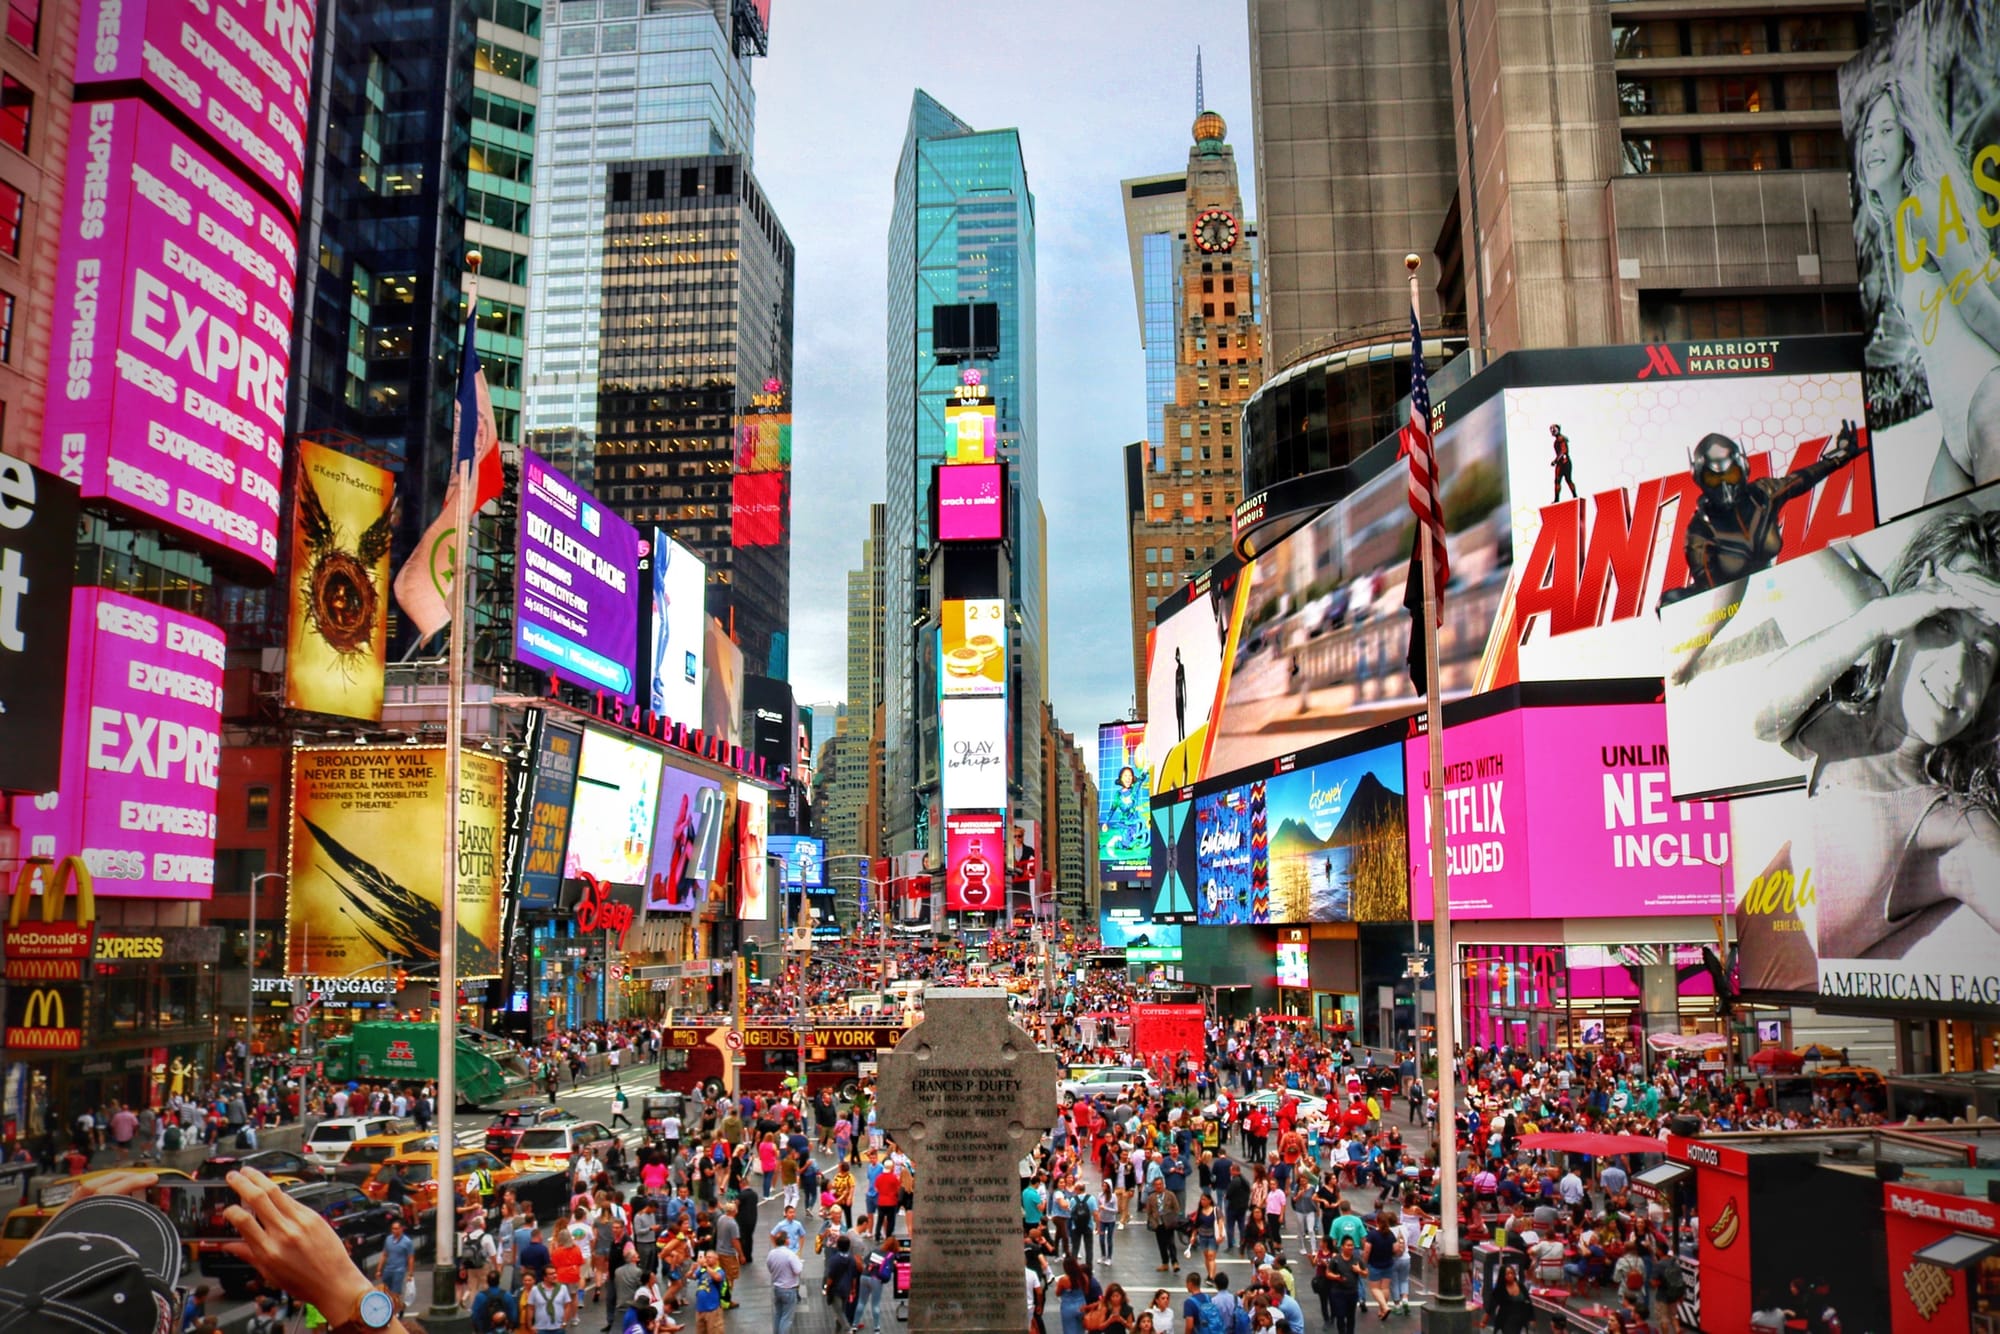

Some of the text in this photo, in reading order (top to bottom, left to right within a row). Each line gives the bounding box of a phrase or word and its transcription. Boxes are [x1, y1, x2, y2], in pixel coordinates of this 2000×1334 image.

[216, 5, 292, 94] EXPRESS
[180, 22, 263, 113] EXPRESS
[208, 97, 285, 181] EXPRESS
[81, 103, 114, 240] EXPRESS
[171, 143, 254, 226] EXPRESS
[198, 213, 276, 288] EXPRESS
[163, 239, 247, 316] EXPRESS
[66, 259, 101, 401] EXPRESS
[1689, 342, 1780, 357] MARRIOTT
[1689, 357, 1771, 372] MARQUIS
[183, 387, 265, 452] EXPRESS
[148, 420, 236, 485] EXPRESS
[313, 463, 385, 497] #KeepTheSecrets
[941, 496, 965, 505] crack
[176, 488, 258, 546] EXPRESS
[968, 606, 1000, 620] 2 3
[128, 660, 214, 709] EXPRESS
[661, 714, 767, 779] BROADWAY
[953, 741, 994, 754] OLAY
[304, 767, 437, 780] NEVER BE THE SAME.
[395, 755, 427, 766] WILL
[1476, 753, 1504, 779] WITH
[310, 790, 429, 800] REDEFINES THE POSSIBILITIES
[320, 782, 369, 790] THEATRICAL
[371, 781, 403, 789] MARVEL
[406, 780, 429, 788] THAT
[460, 788, 476, 805] EST
[120, 800, 207, 837] EXPRESS
[341, 801, 352, 810] OF
[534, 802, 569, 826] COME
[1423, 780, 1505, 845] NTFLIX
[458, 850, 497, 879] OTTER
[526, 849, 562, 875] AWAY
[1428, 841, 1504, 878] ICLUDED
[7, 932, 87, 945] McDonald's
[95, 937, 163, 959] EXPRESS
[1820, 971, 1942, 1001] AMERICAN
[793, 1030, 829, 1046] NW
[833, 1030, 876, 1046] YORK
[912, 1080, 963, 1092] FRANCIS
[979, 1080, 1022, 1092] DUFFY
[975, 1109, 1008, 1118] PRIEST
[973, 1177, 1009, 1185] SERVICE
[969, 1195, 1011, 1203] COUNTRY
